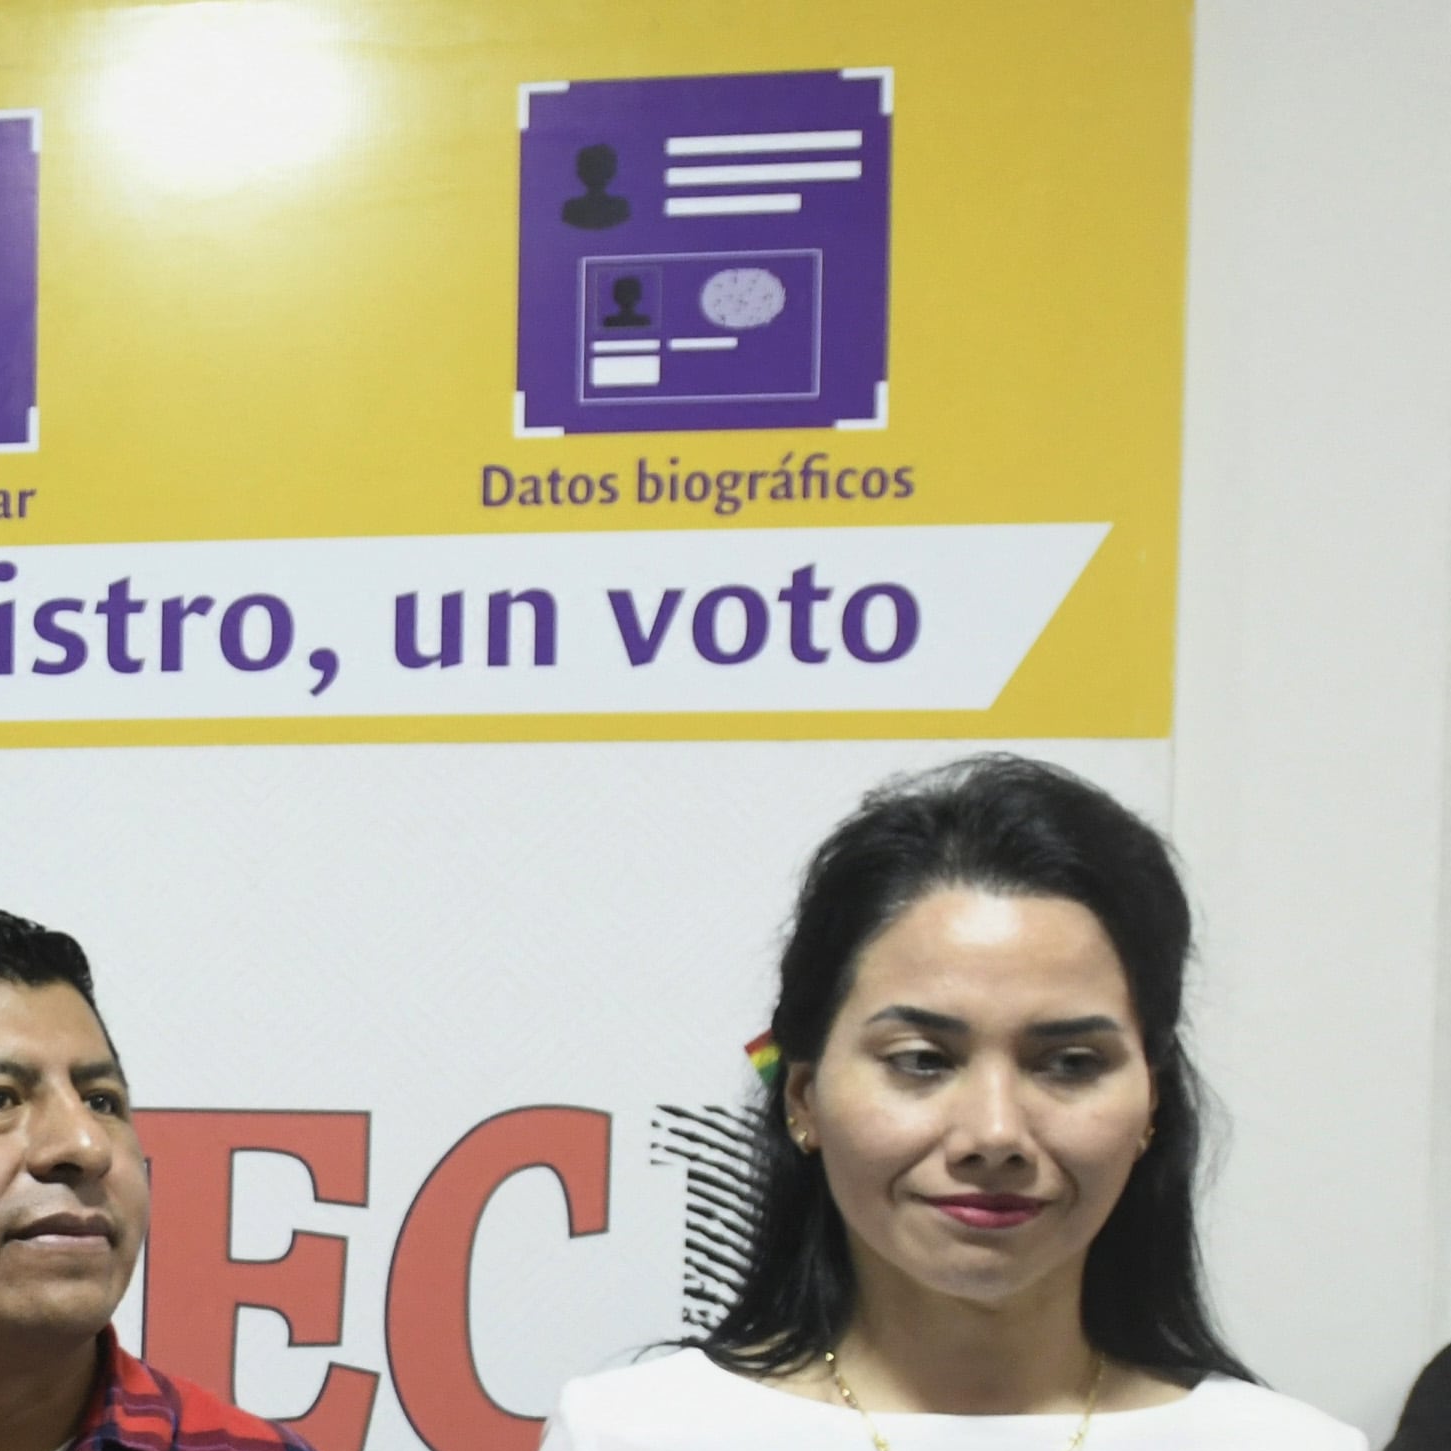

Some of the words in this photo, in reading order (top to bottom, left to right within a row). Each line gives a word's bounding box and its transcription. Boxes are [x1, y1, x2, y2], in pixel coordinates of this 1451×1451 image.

[482, 464, 619, 508] Datos
[637, 452, 915, 516] biográficos
[395, 587, 558, 670] un
[607, 563, 921, 669] voto
